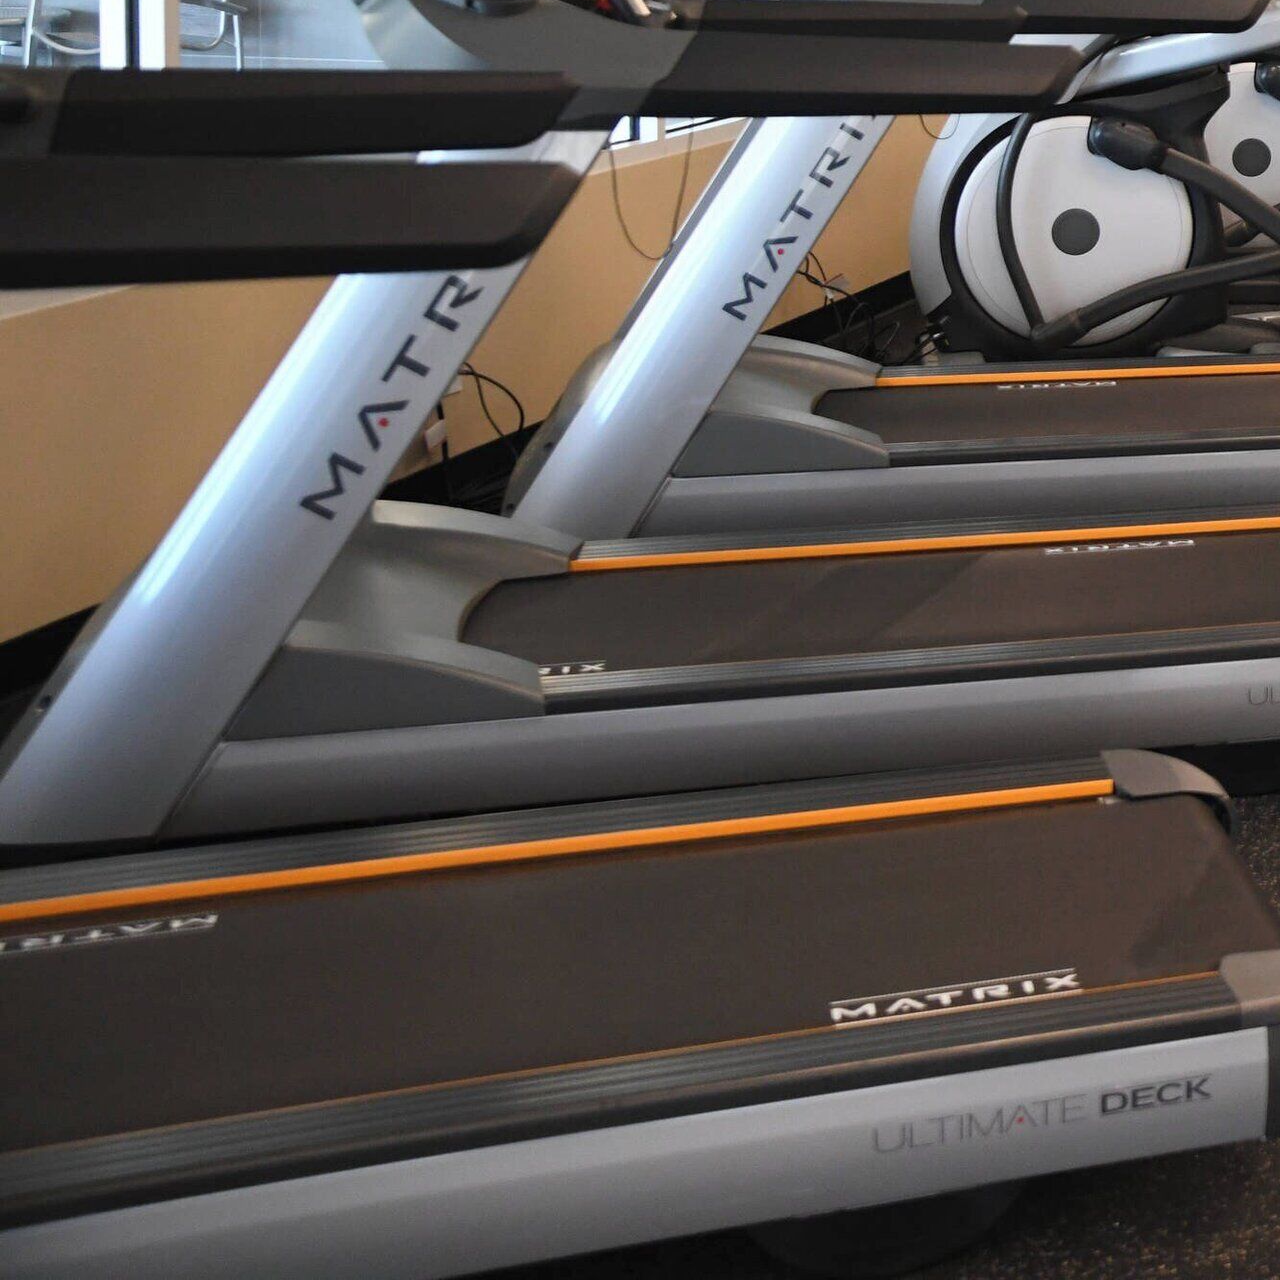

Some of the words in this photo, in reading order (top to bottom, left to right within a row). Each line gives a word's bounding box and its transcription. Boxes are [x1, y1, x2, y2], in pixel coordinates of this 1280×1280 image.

[722, 120, 866, 321] MATRI
[300, 273, 486, 521] MATR
[830, 972, 1080, 1023] MATRIX
[872, 1093, 1088, 1154] ULTIMATE
[1101, 1077, 1213, 1116] DECK
